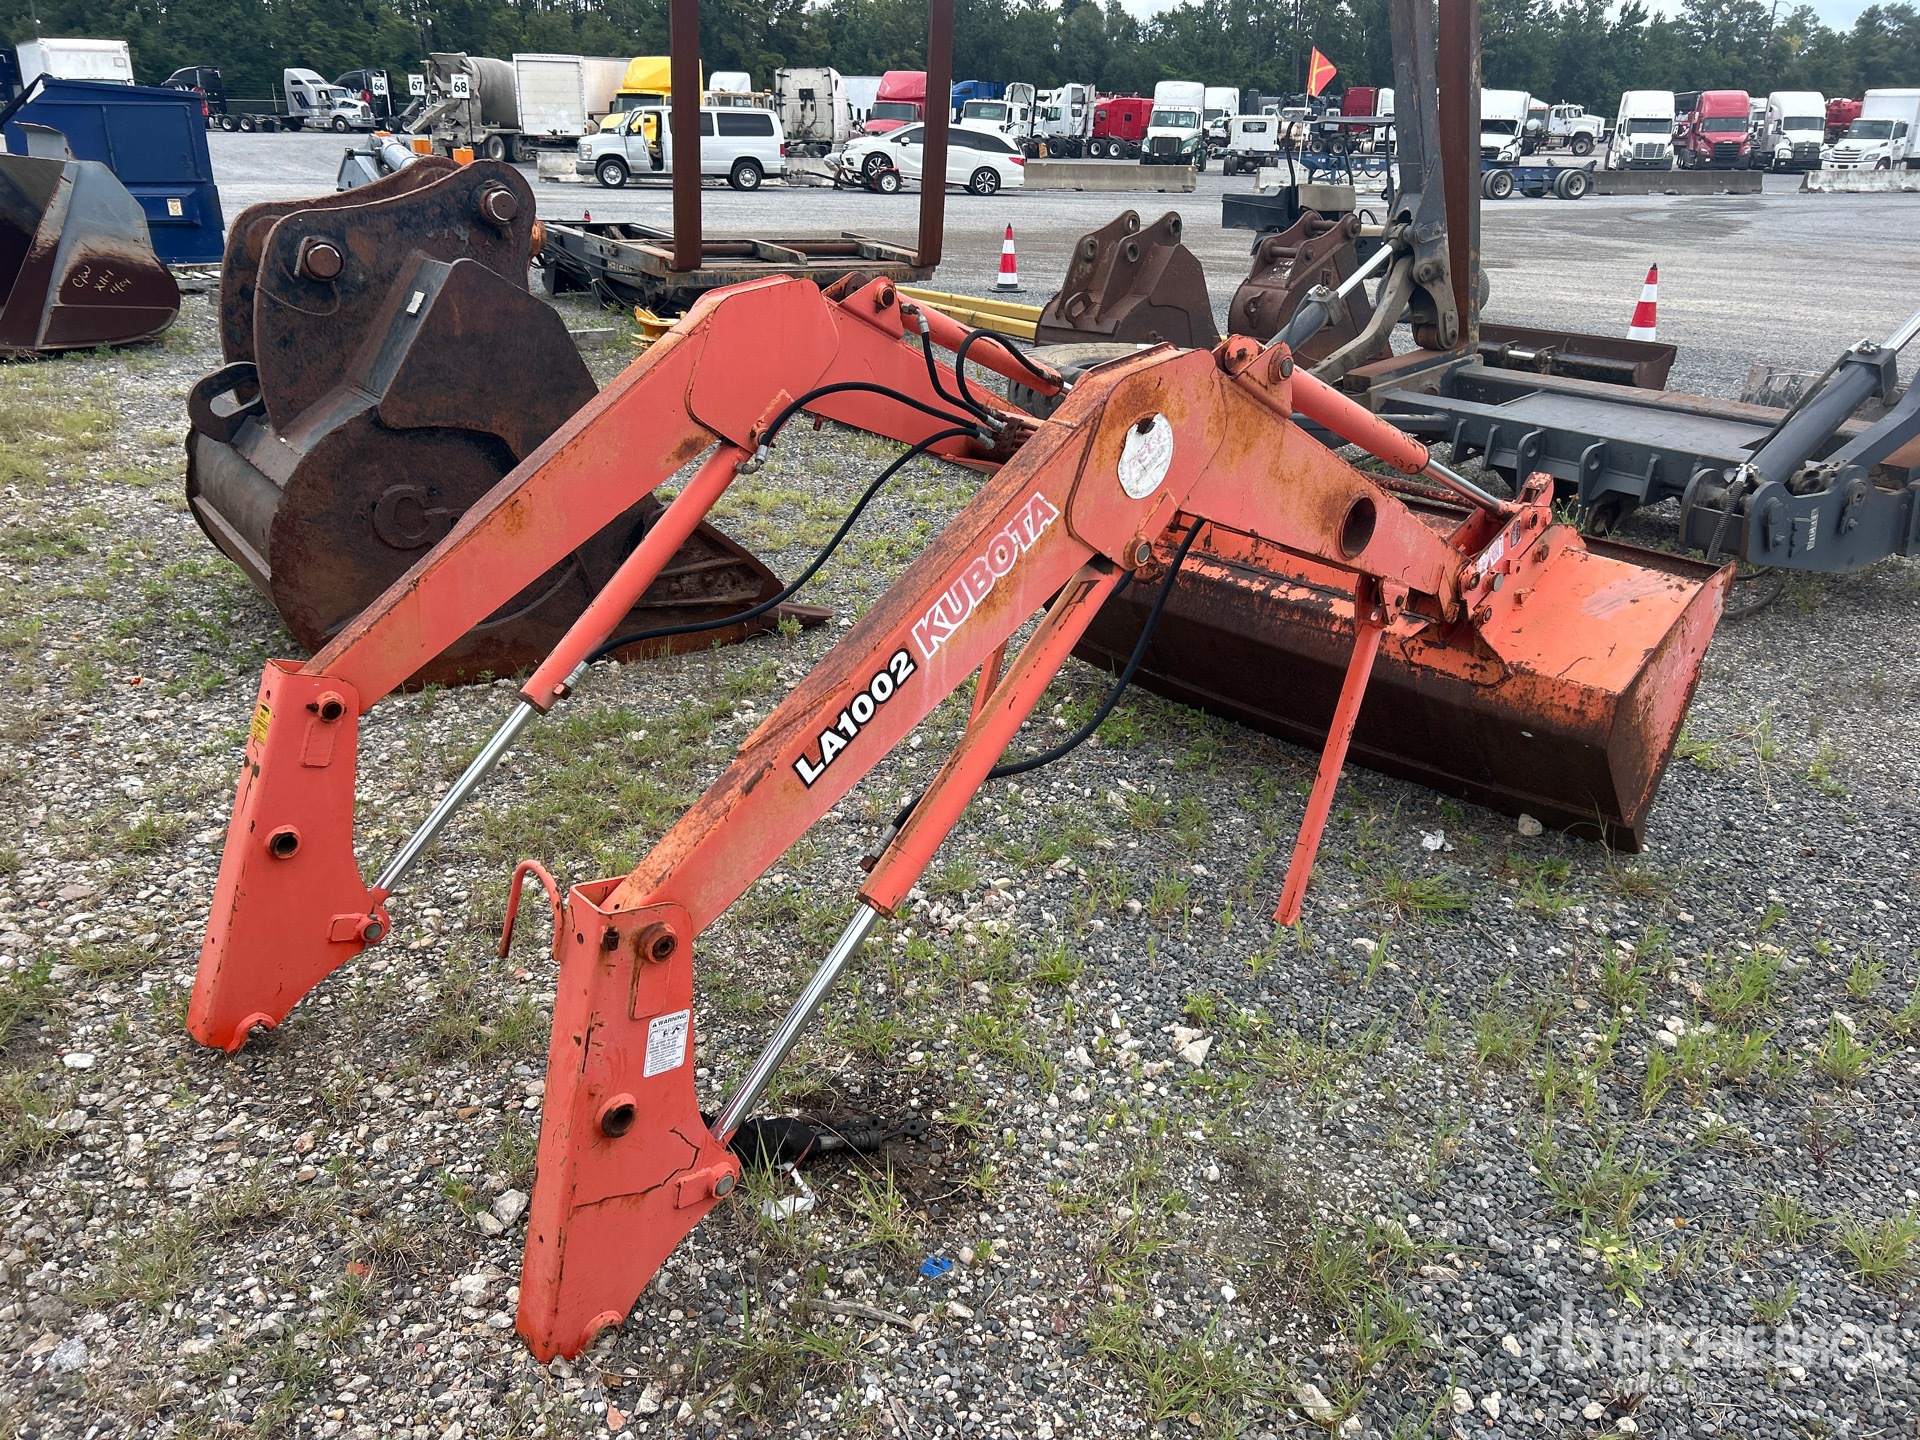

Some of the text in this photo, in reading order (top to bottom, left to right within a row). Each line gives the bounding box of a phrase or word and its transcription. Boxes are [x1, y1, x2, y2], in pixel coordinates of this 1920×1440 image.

[374, 82, 385, 91] 66
[411, 81, 423, 91] 67
[453, 81, 468, 93] 68
[793, 492, 1060, 788] LA1002 KUBOTA
[657, 1013, 687, 1025] WARNING
